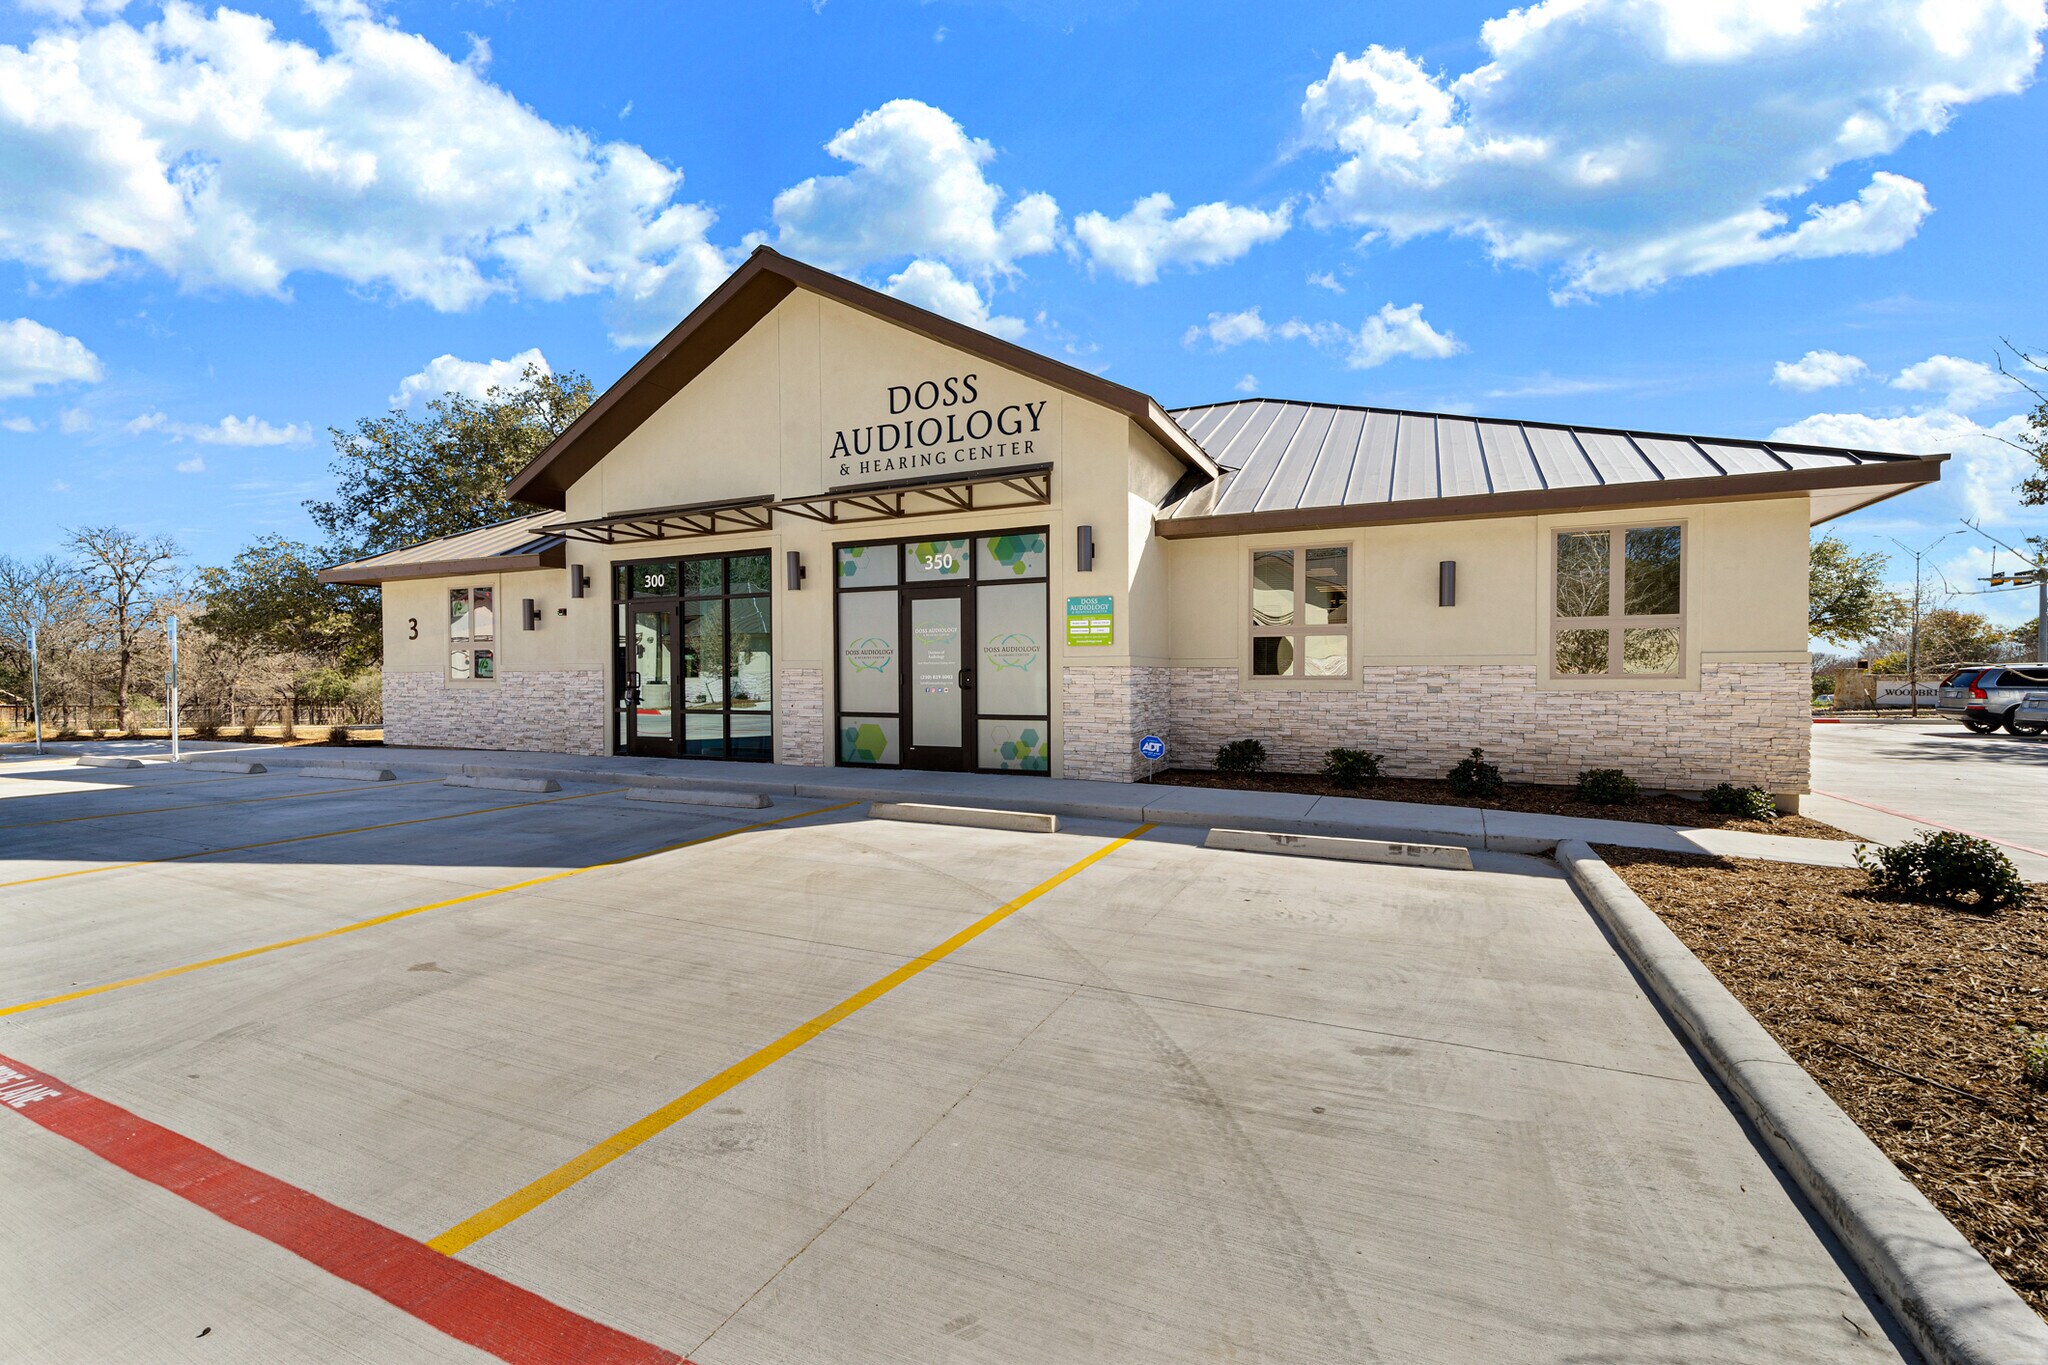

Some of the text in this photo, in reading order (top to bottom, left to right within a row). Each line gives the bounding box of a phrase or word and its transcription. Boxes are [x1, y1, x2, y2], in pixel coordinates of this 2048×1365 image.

[887, 374, 978, 415] DOSS
[829, 401, 1047, 459] AUDIOLOGY
[840, 440, 1035, 476] & HEARING CENTER
[925, 554, 952, 570] 350
[644, 574, 665, 588] 300
[408, 617, 419, 640] 3
[1885, 688, 1938, 697] WOODBRI
[1141, 742, 1162, 752] ADT
